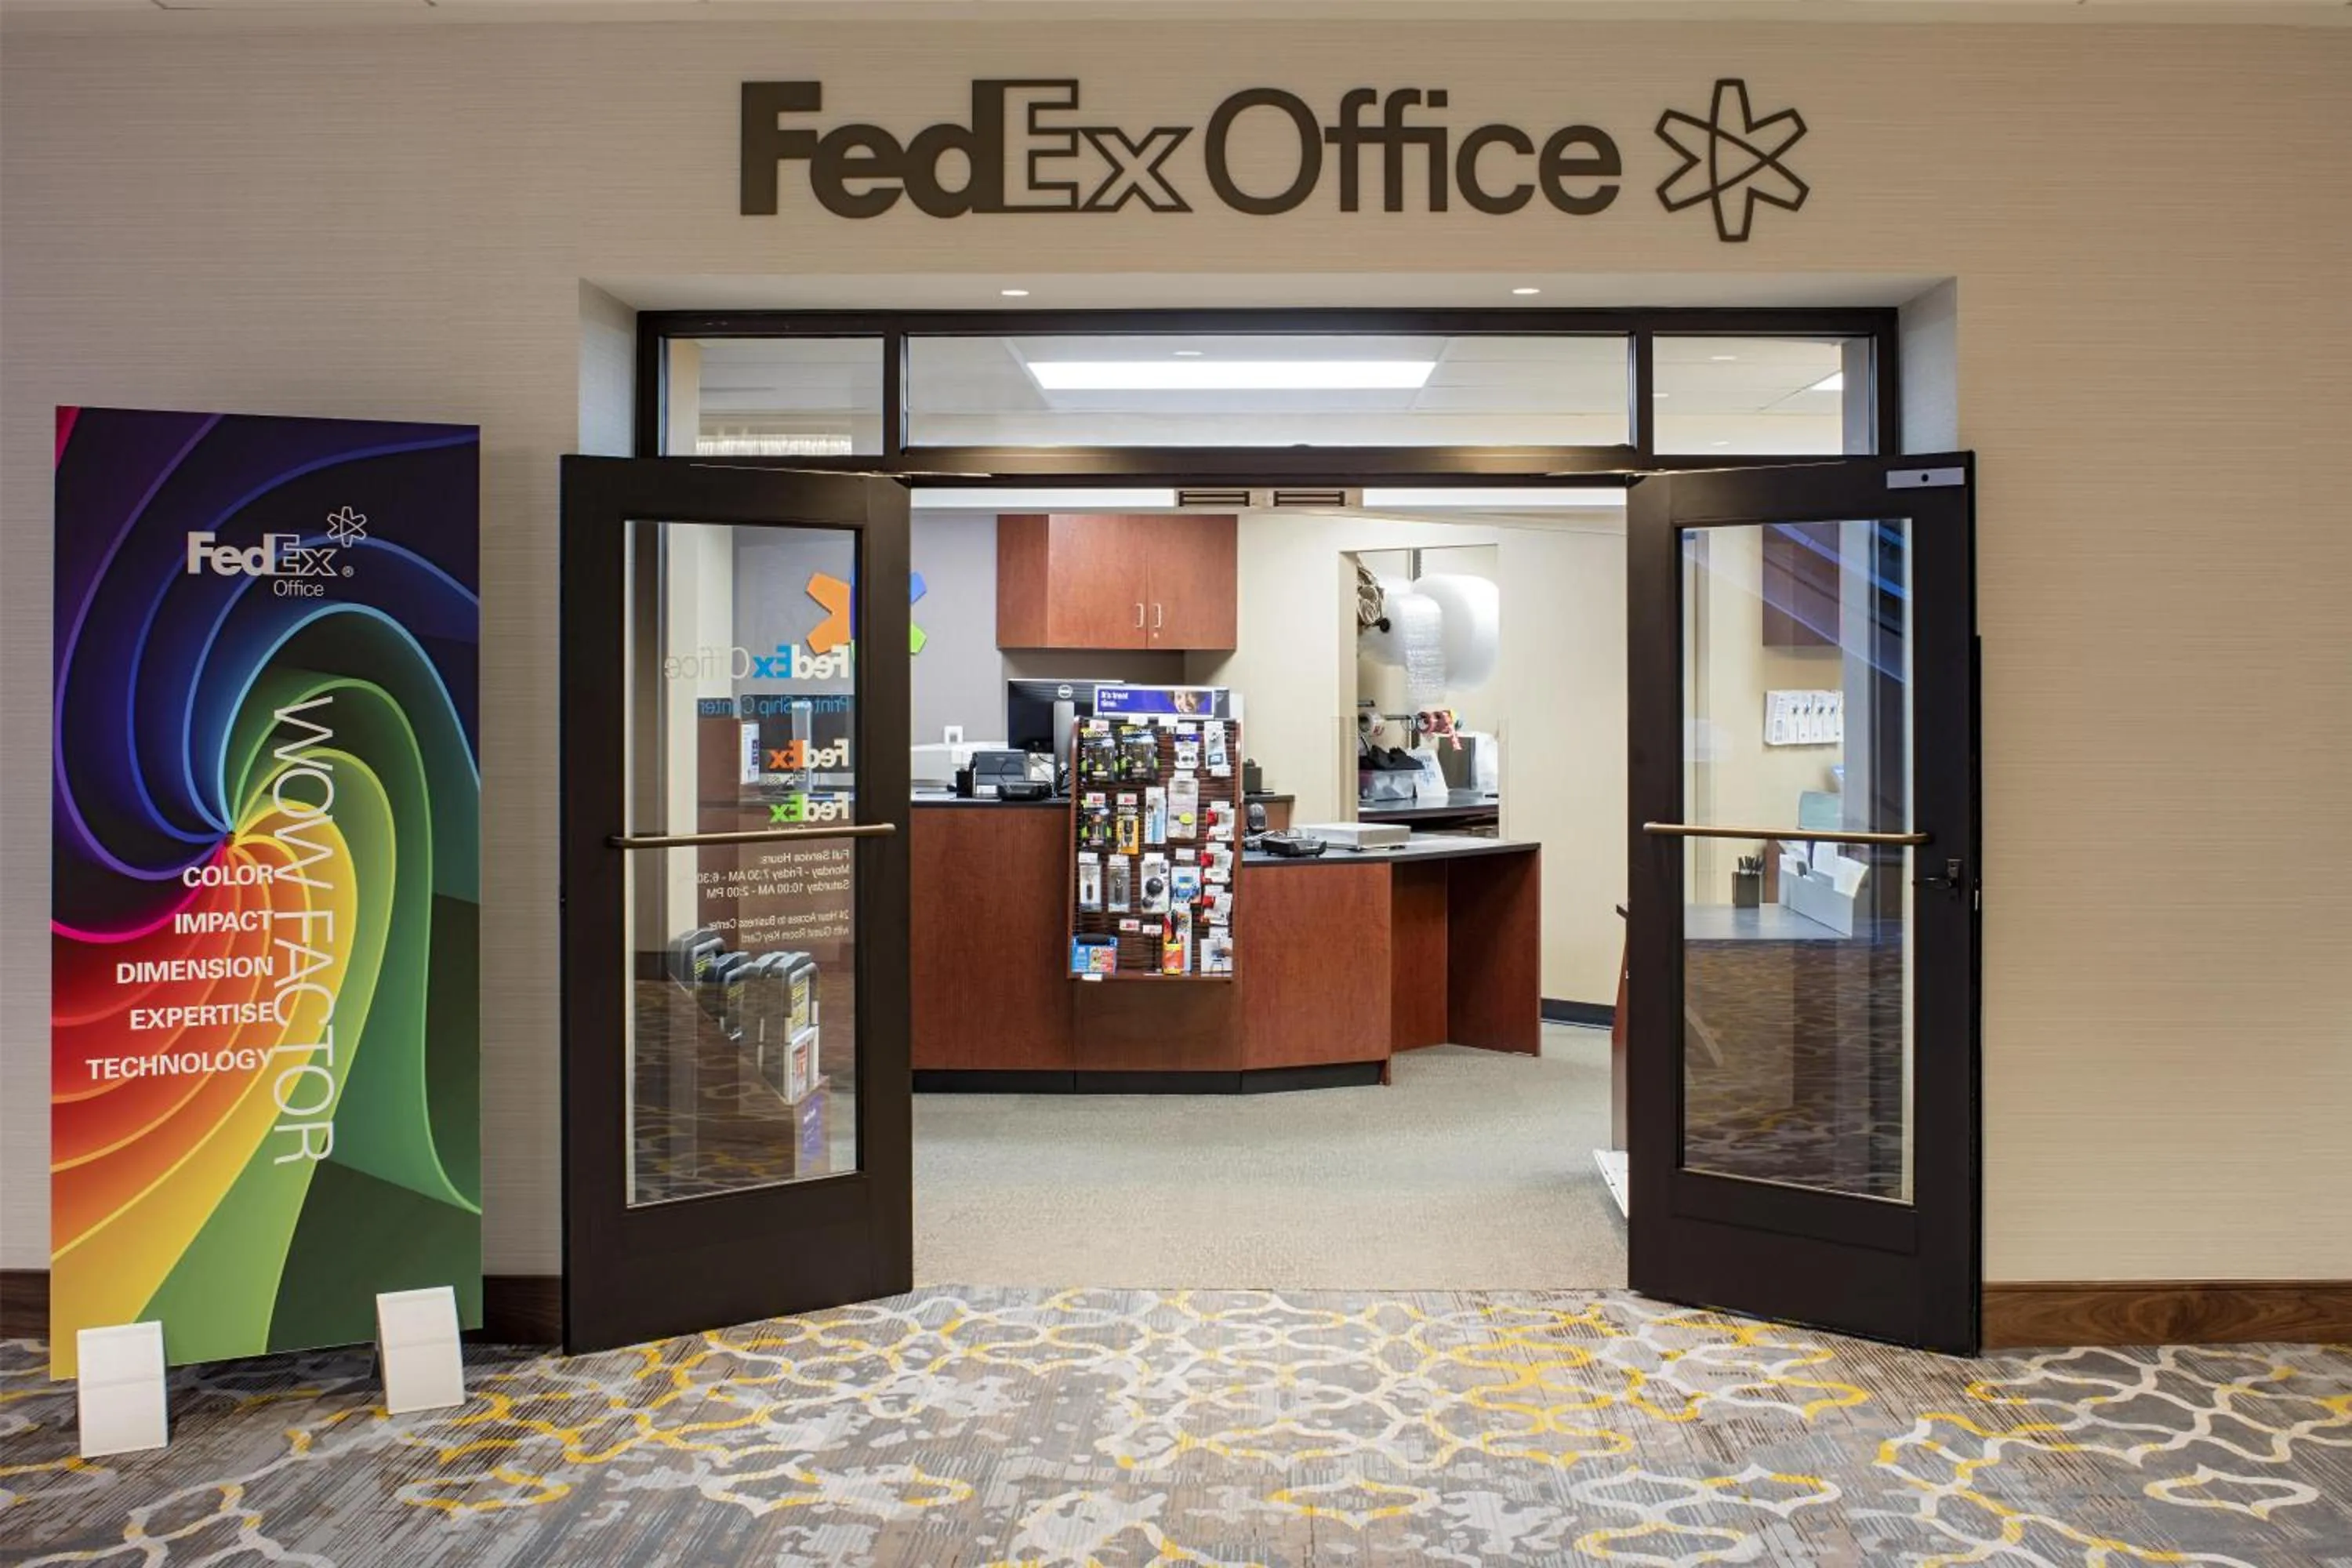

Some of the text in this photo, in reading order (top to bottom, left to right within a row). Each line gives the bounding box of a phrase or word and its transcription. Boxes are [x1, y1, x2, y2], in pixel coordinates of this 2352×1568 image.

[740, 78, 1623, 219] FedEx Office
[274, 579, 324, 597] Office
[183, 864, 274, 887] COLOR
[175, 909, 274, 934] IMPACT
[273, 696, 335, 1166] WOW FACTOR
[116, 956, 274, 984] DIMENSION
[129, 1001, 274, 1030] EXPERTISE
[85, 1047, 273, 1080] TECHNOLOGY
